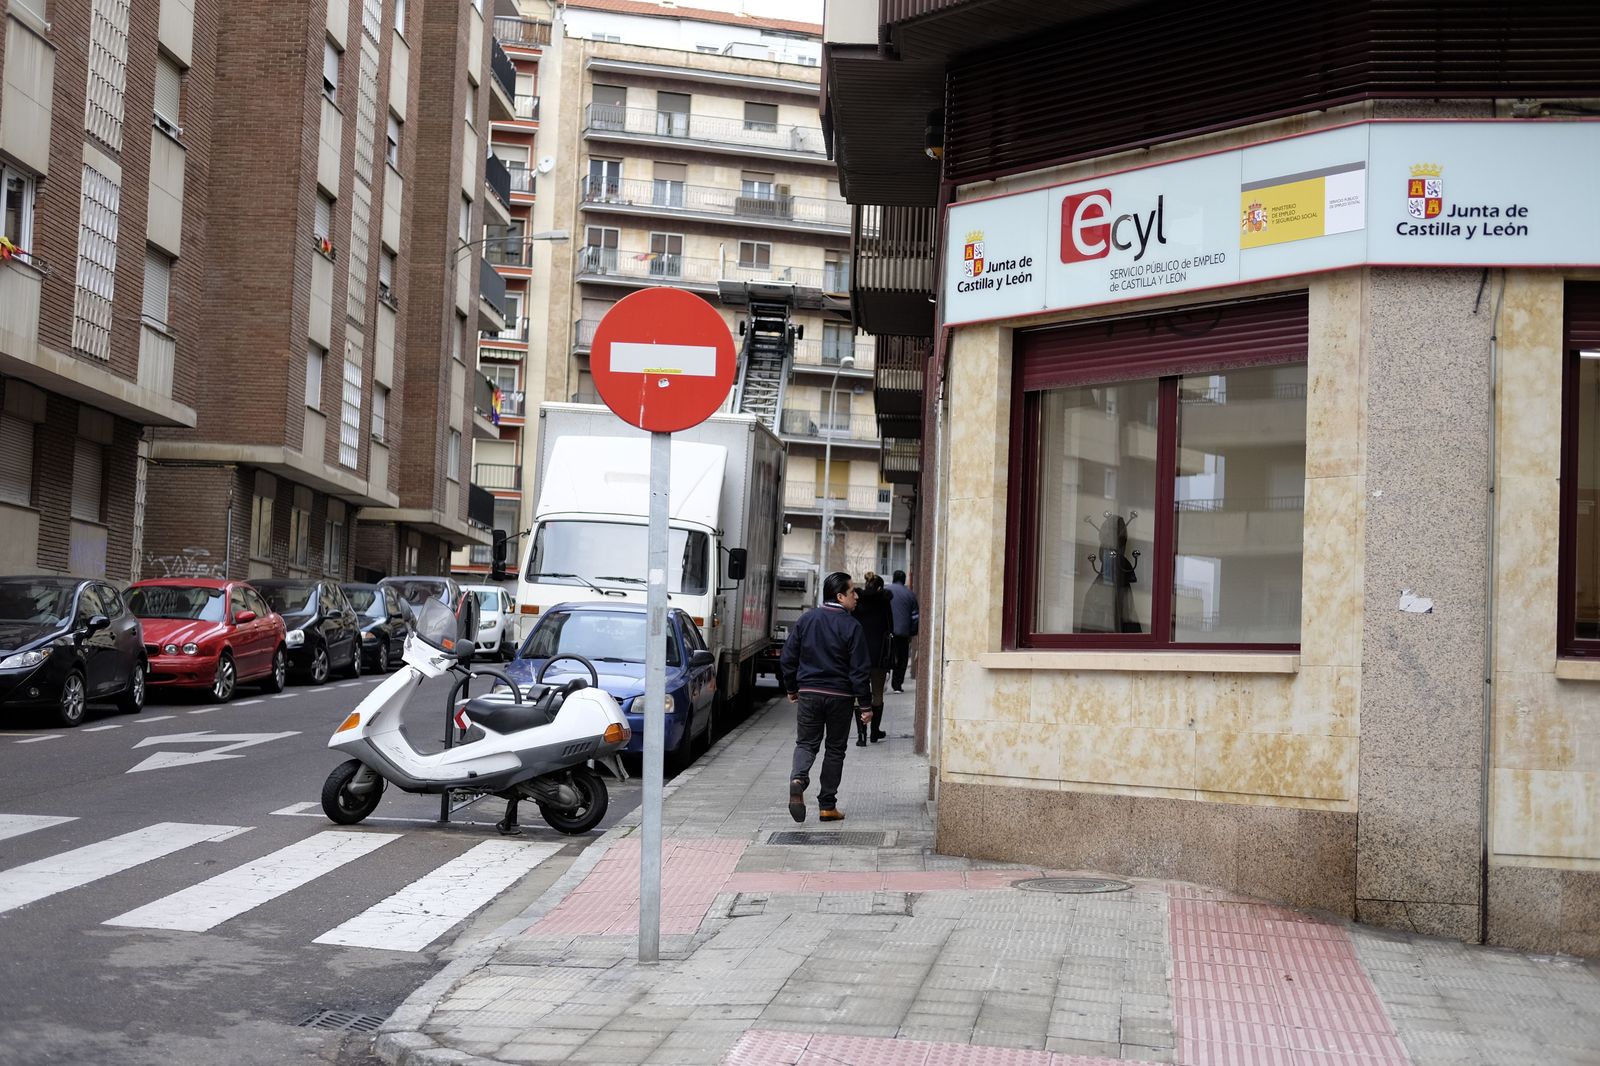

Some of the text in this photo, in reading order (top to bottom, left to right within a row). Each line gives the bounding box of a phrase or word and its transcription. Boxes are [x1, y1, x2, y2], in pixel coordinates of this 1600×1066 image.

[1447, 204, 1529, 218] Junta de
[1072, 194, 1167, 262] ecyl
[1396, 222, 1528, 240] Castilla y León
[986, 256, 1033, 274] Junta de
[1110, 252, 1226, 280] SERVICIO PÚBLICO de EMPLEO
[957, 271, 1032, 293] Castilla y León
[1109, 271, 1187, 292] de CASTILLA Y LEÓN
